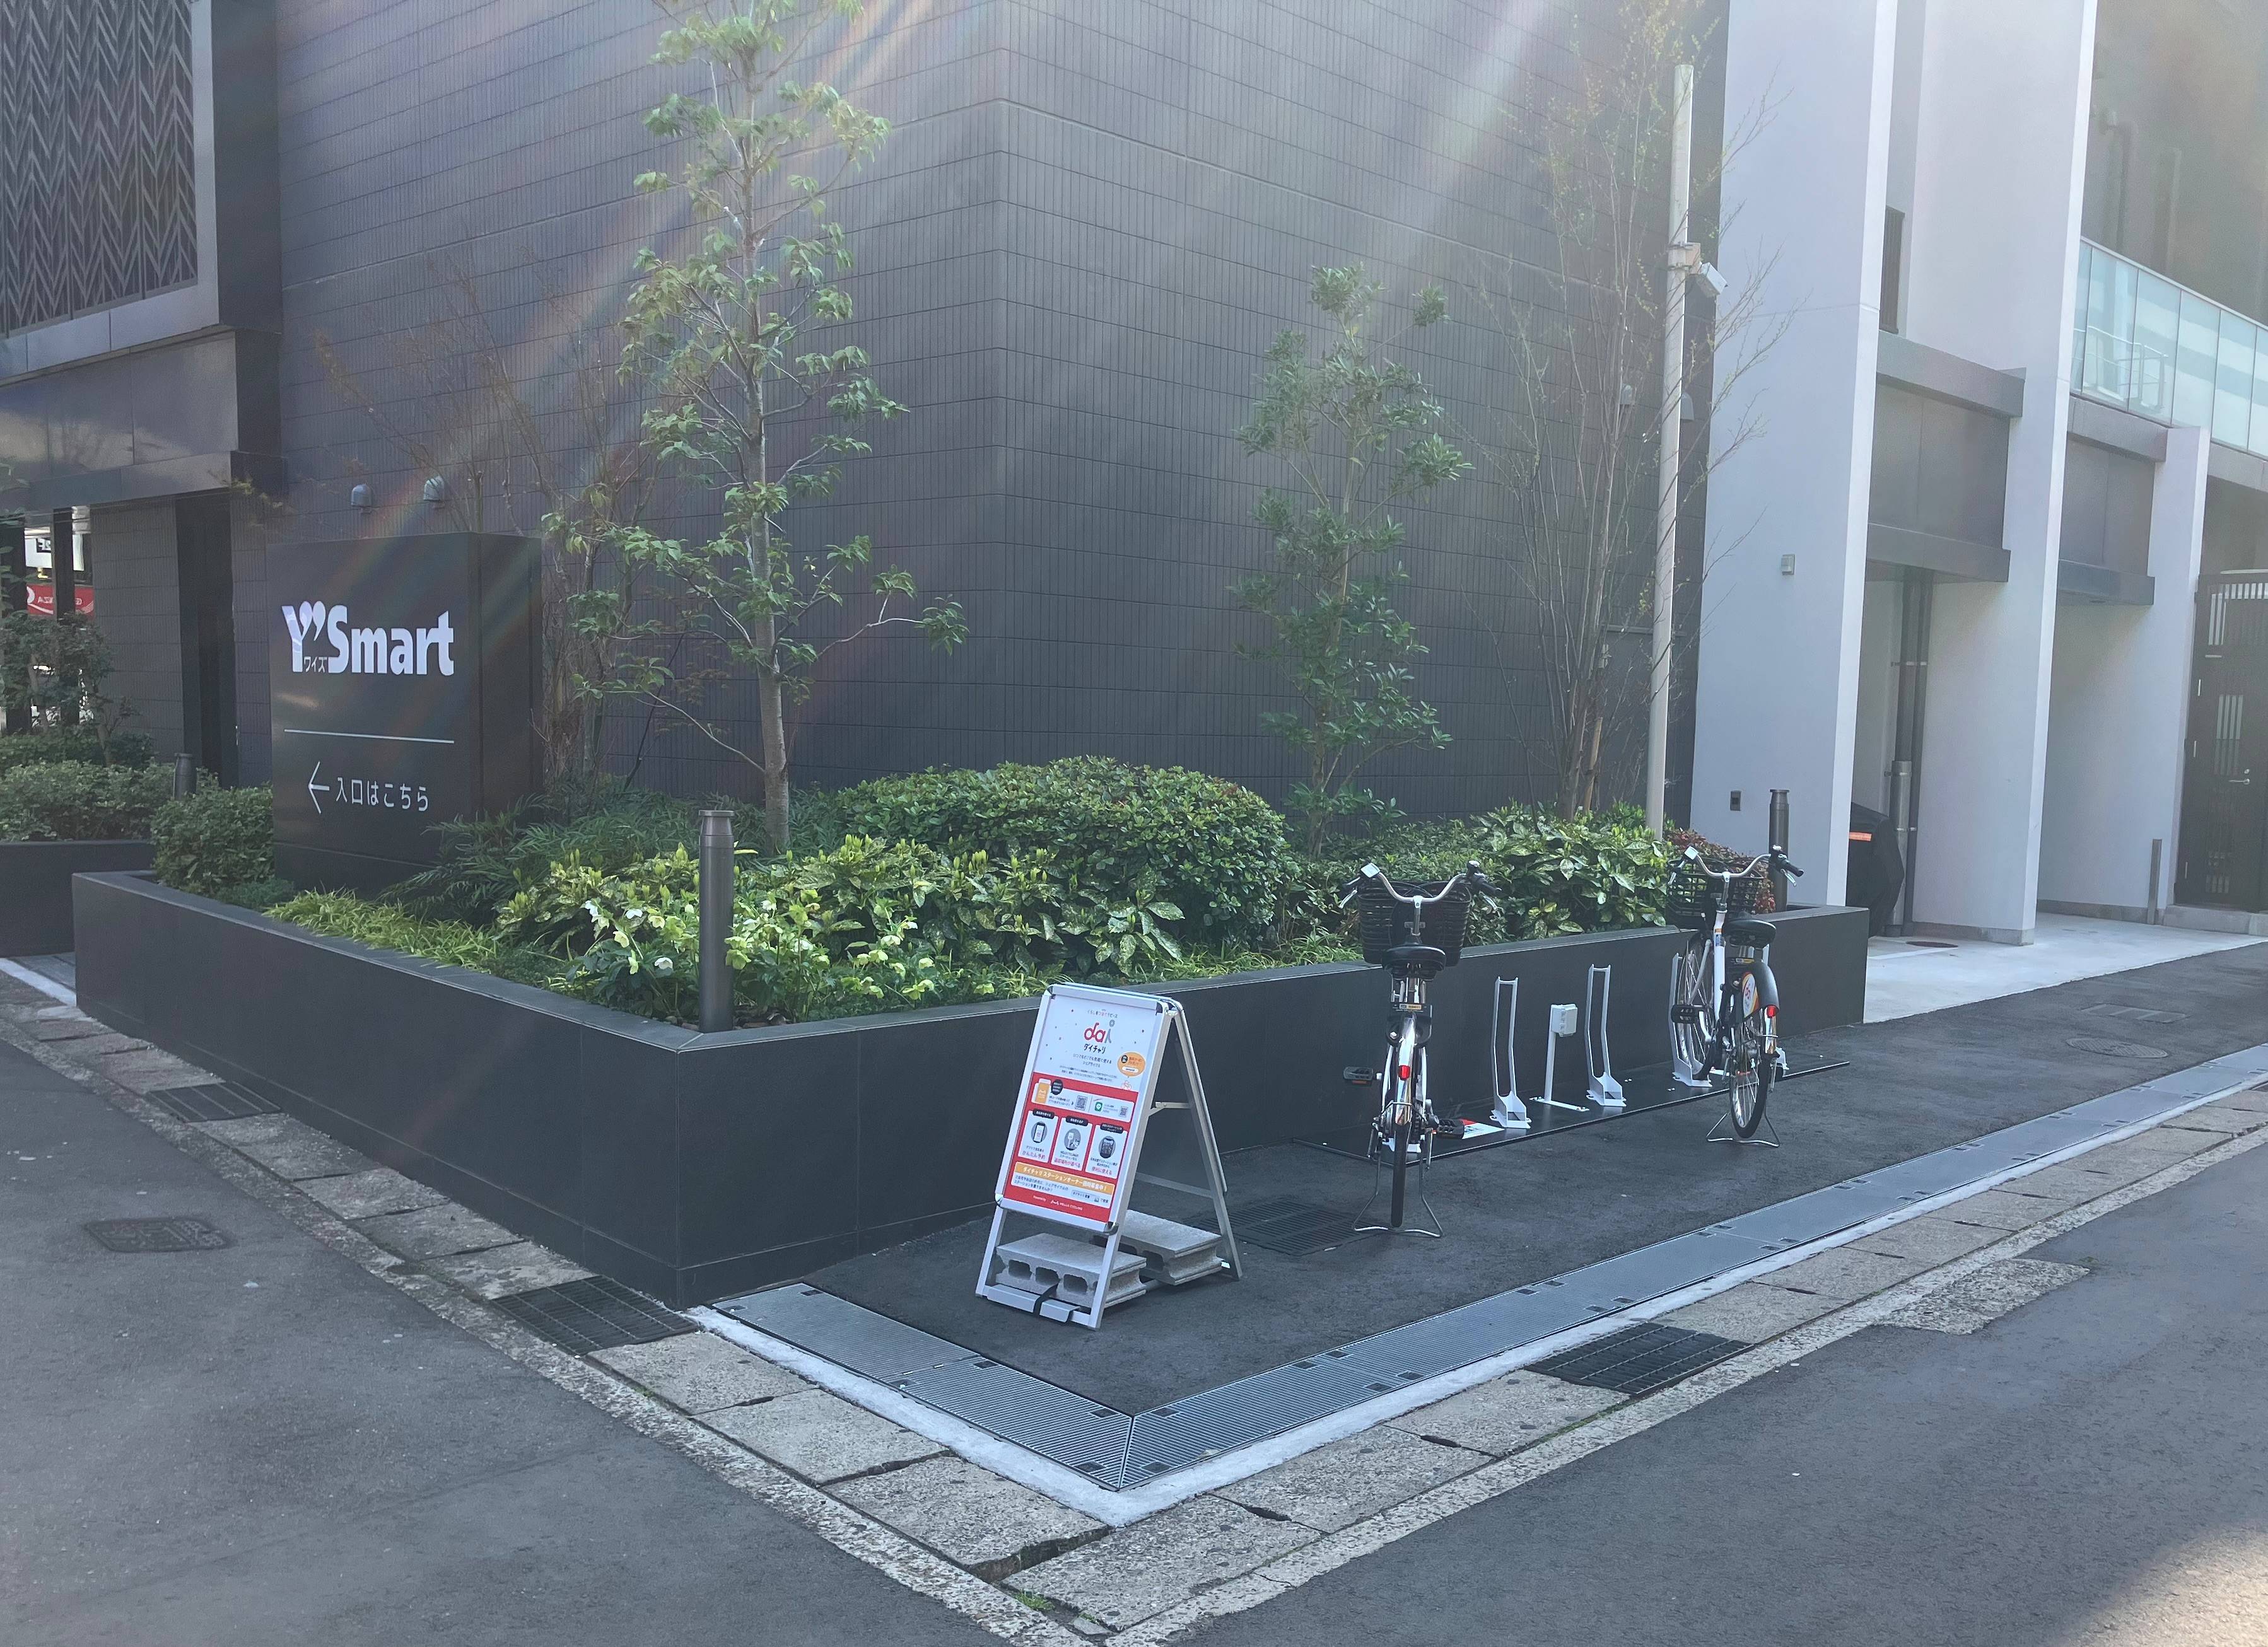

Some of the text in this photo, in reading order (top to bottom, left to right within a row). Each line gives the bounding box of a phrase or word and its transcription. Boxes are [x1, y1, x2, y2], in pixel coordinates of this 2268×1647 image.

[303, 656, 328, 673] ワイズ
[336, 777, 428, 812] 入口はこちら
[1084, 1044, 1106, 1054] ダイチャリ
